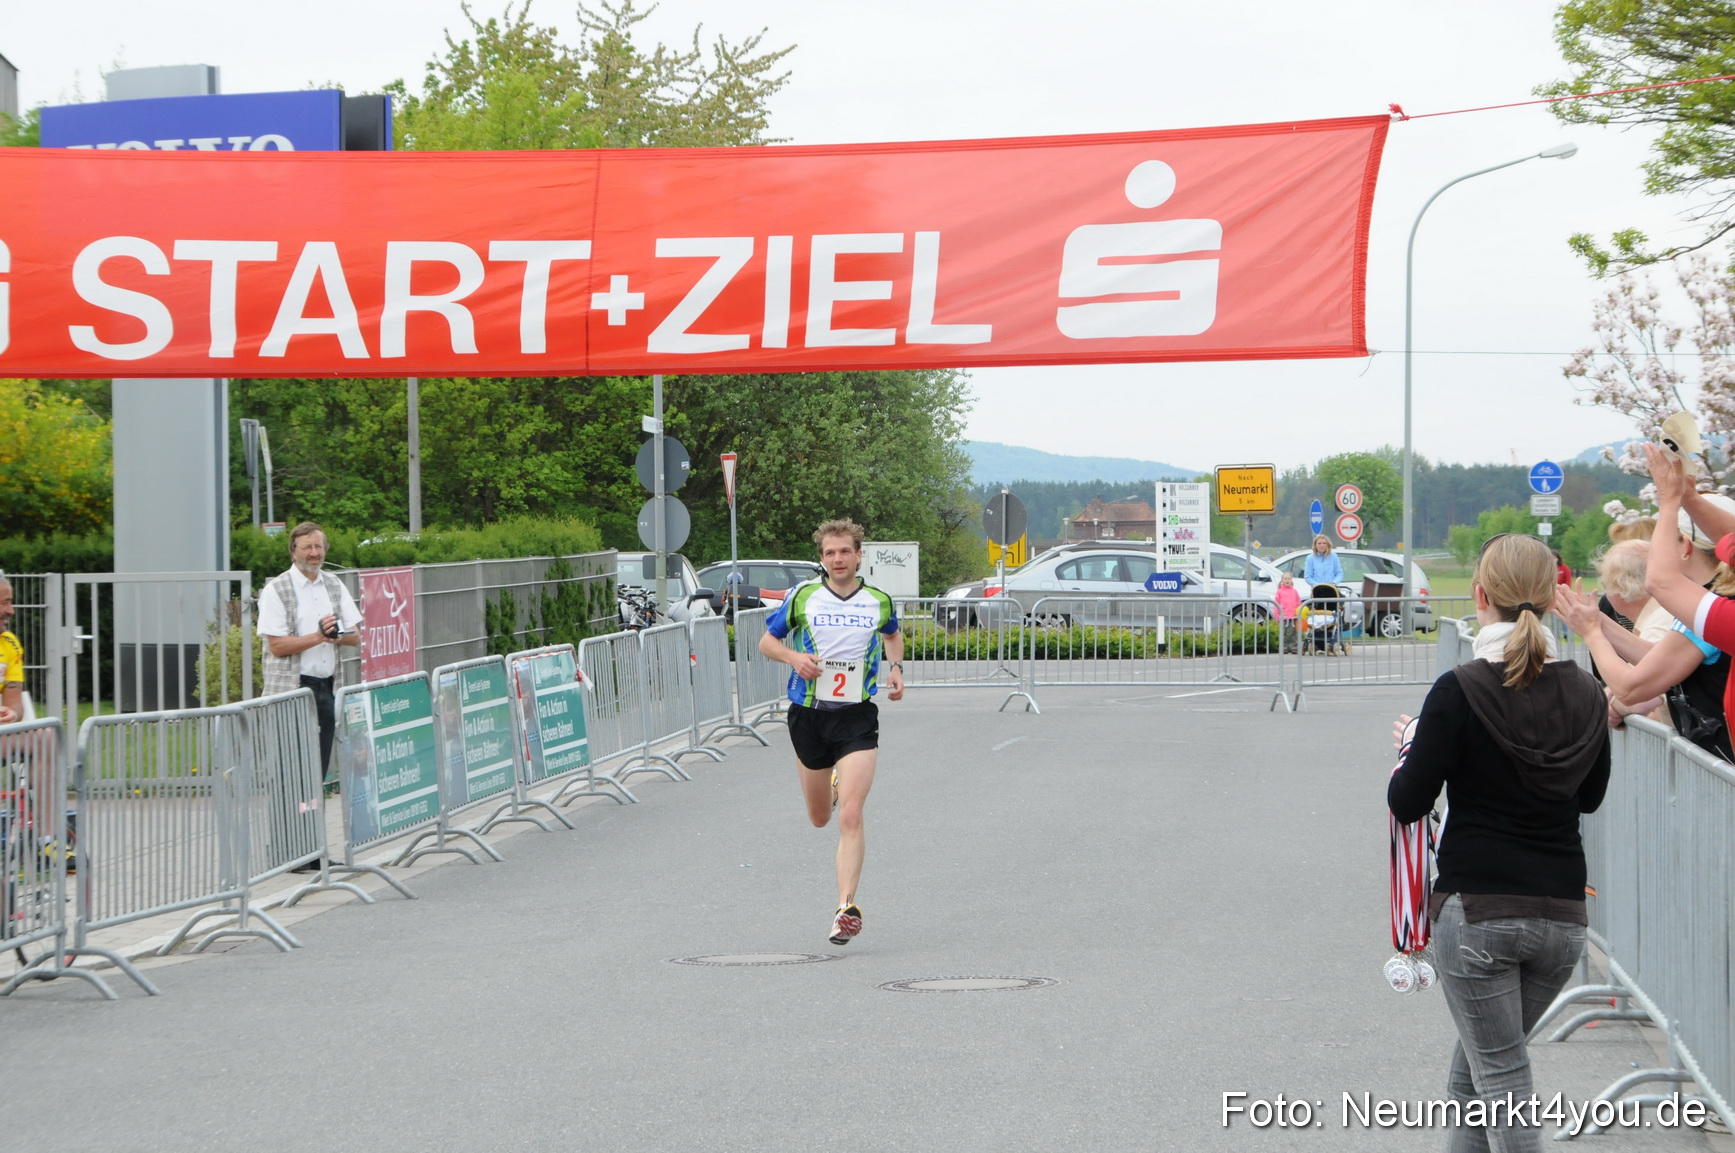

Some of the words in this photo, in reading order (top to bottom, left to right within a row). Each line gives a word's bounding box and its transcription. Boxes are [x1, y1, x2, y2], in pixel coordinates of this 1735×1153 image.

[1223, 483, 1269, 494] Neumarkt
[1342, 492, 1357, 505] 60
[1168, 544, 1186, 555] THULE
[1152, 580, 1178, 590] VOLVO
[814, 613, 873, 628] BOCK
[370, 622, 410, 658] ZEITLOS
[832, 672, 847, 697] 2
[538, 702, 547, 718] Fun
[550, 698, 564, 716] Action
[562, 696, 568, 712] in
[465, 720, 473, 738] Fun
[376, 744, 387, 764] Fun
[391, 738, 408, 760] Action
[407, 735, 414, 755] in
[378, 771, 400, 794] sicheren
